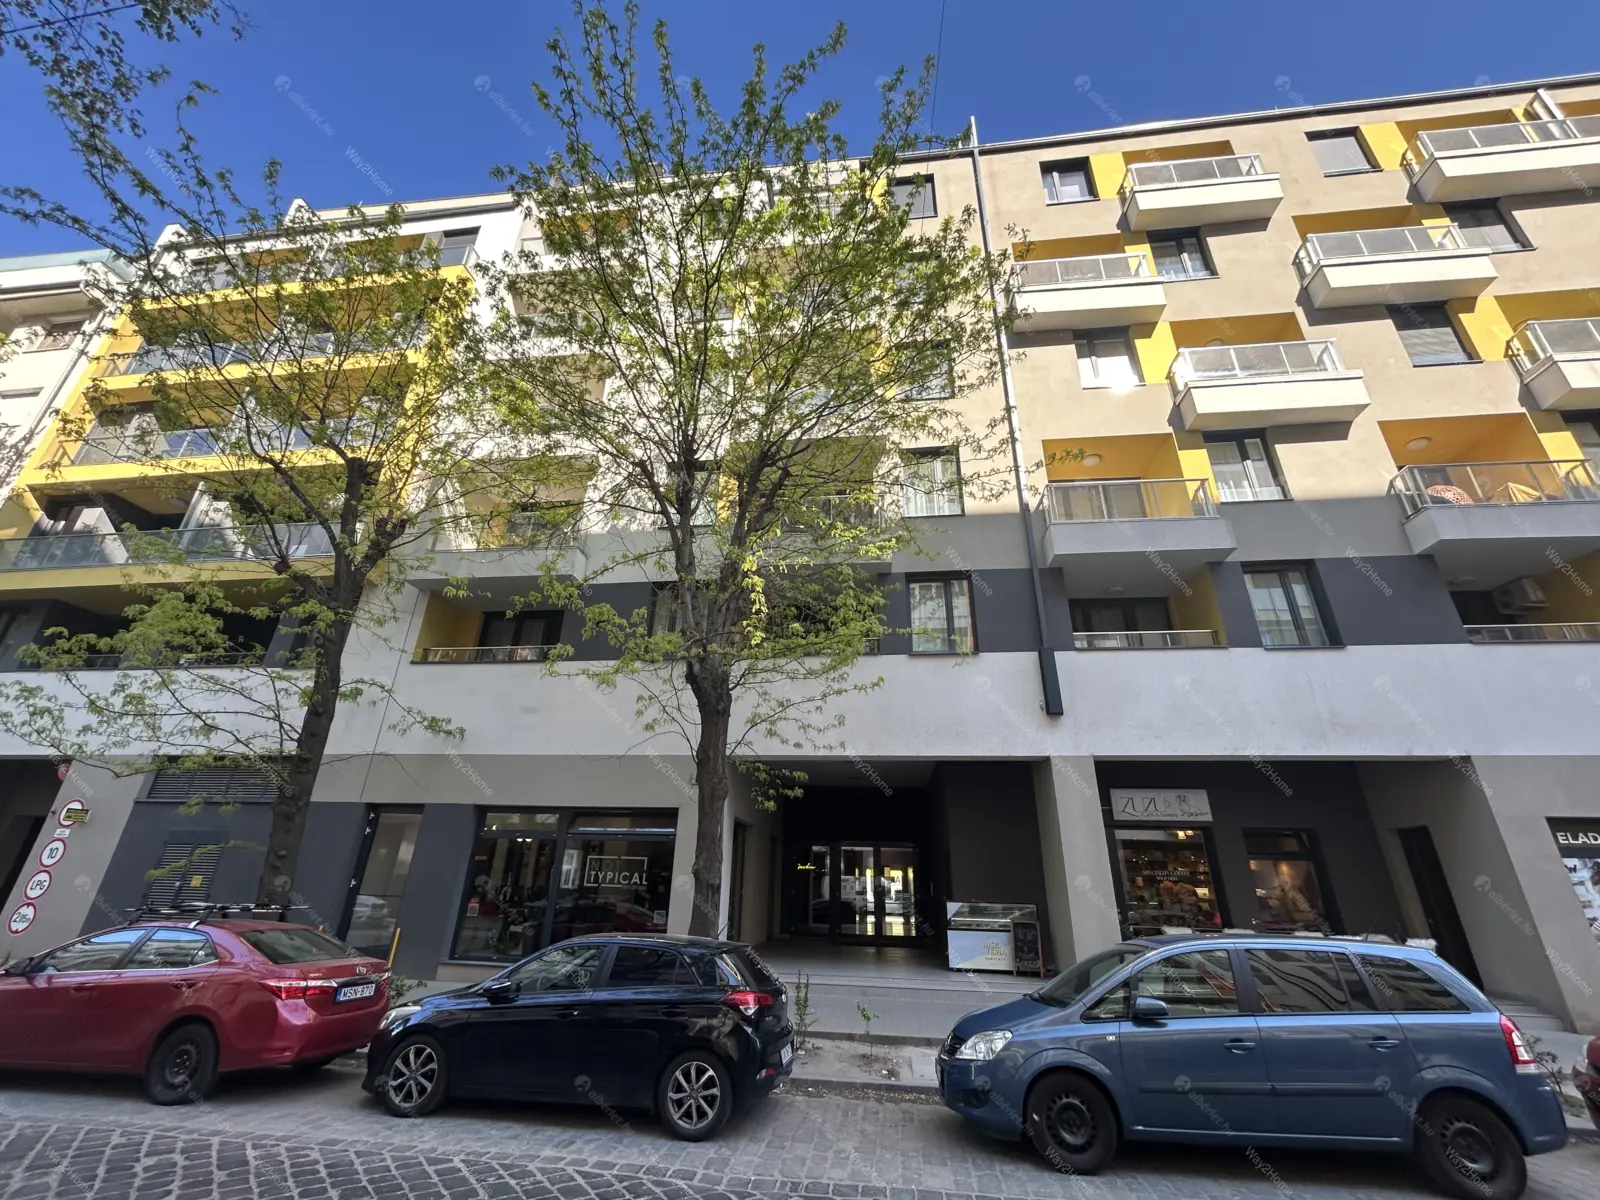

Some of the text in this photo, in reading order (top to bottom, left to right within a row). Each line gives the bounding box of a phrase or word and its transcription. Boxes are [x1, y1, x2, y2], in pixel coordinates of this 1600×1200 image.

[47, 847, 59, 859] 10
[590, 859, 622, 871] NOT
[590, 871, 648, 885] TYPICAL
[29, 879, 48, 891] LPG
[341, 985, 374, 999] MSN-870
